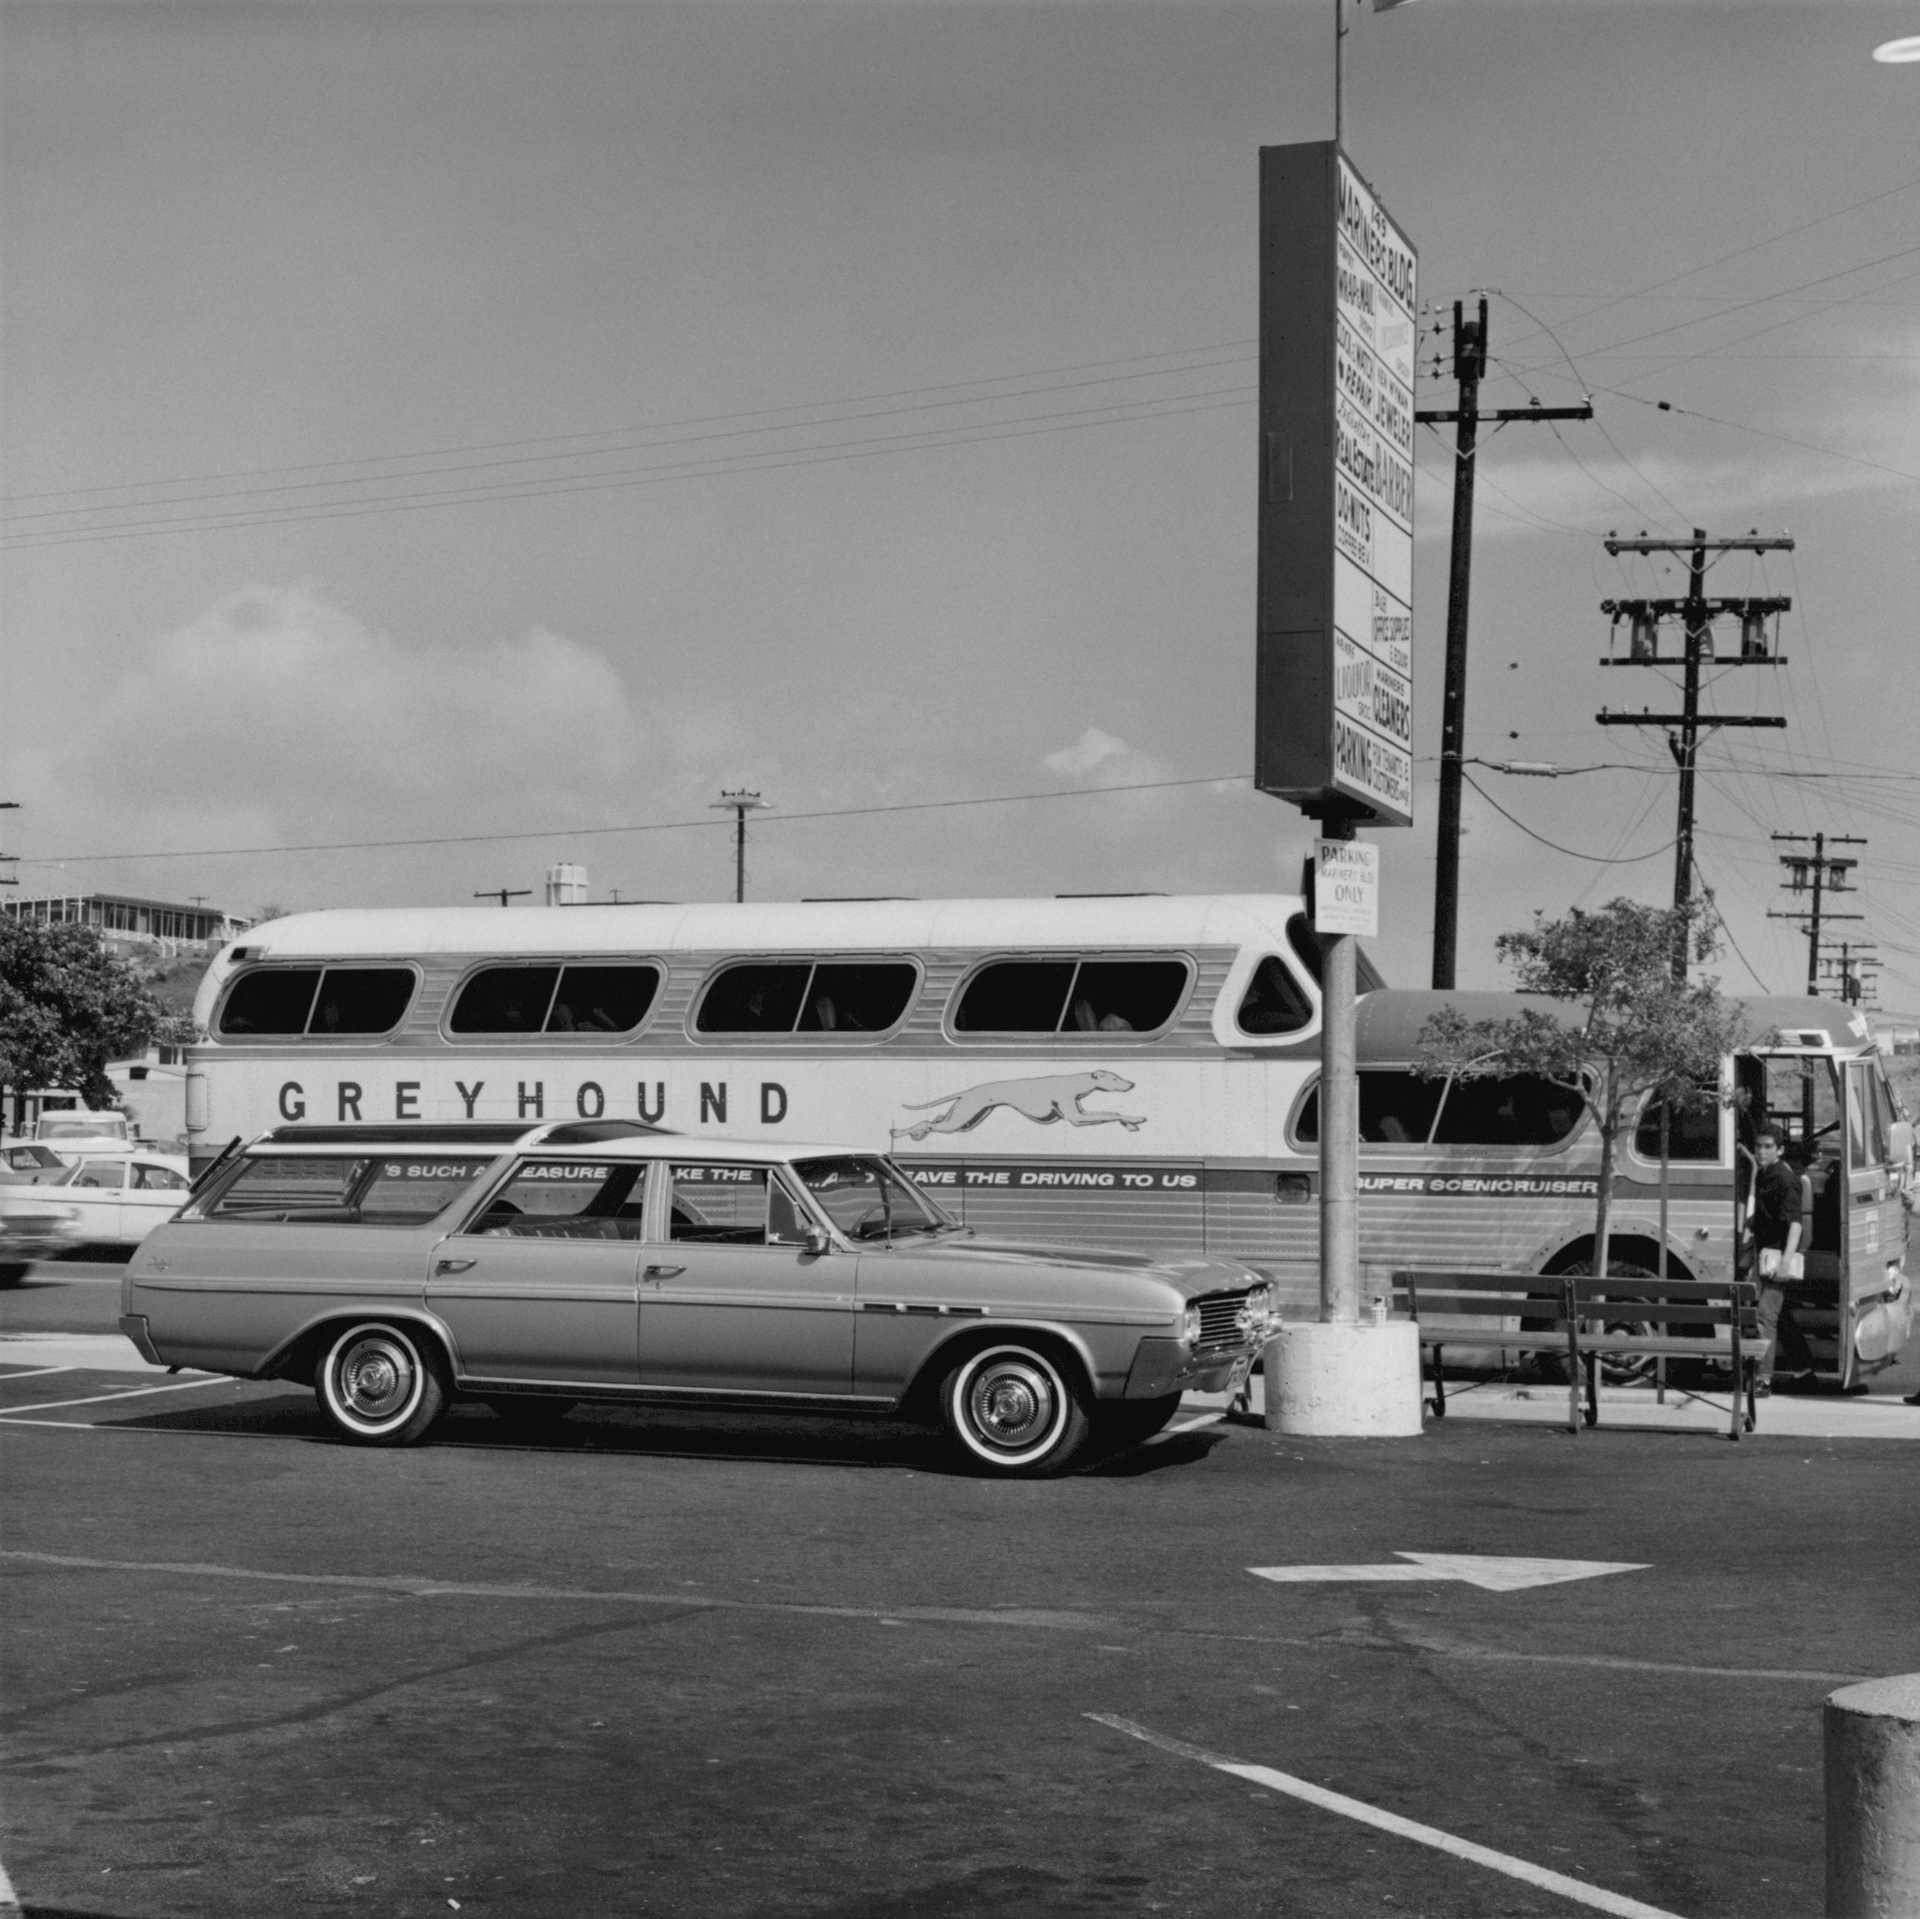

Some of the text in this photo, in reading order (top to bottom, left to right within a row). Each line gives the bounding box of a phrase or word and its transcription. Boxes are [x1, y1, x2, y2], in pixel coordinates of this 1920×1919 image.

[1338, 160, 1386, 280] MARINERS
[1388, 247, 1415, 312] BLDG
[1373, 682, 1410, 742] CLEANERS
[1336, 719, 1372, 787] PARKING
[1321, 845, 1370, 867] PARKING
[1335, 883, 1362, 904] ONLY
[279, 1081, 788, 1125] GREYHOUND
[407, 1165, 466, 1178] SUCH
[519, 1166, 608, 1179] EASURE
[710, 1168, 752, 1181] THE
[903, 1171, 956, 1184] EAVE
[964, 1171, 1011, 1185] THE
[1020, 1172, 1114, 1187] DRIVING
[1121, 1174, 1154, 1187] TO
[1161, 1175, 1197, 1188] US
[1429, 1179, 1598, 1194] SCENICRUISER
